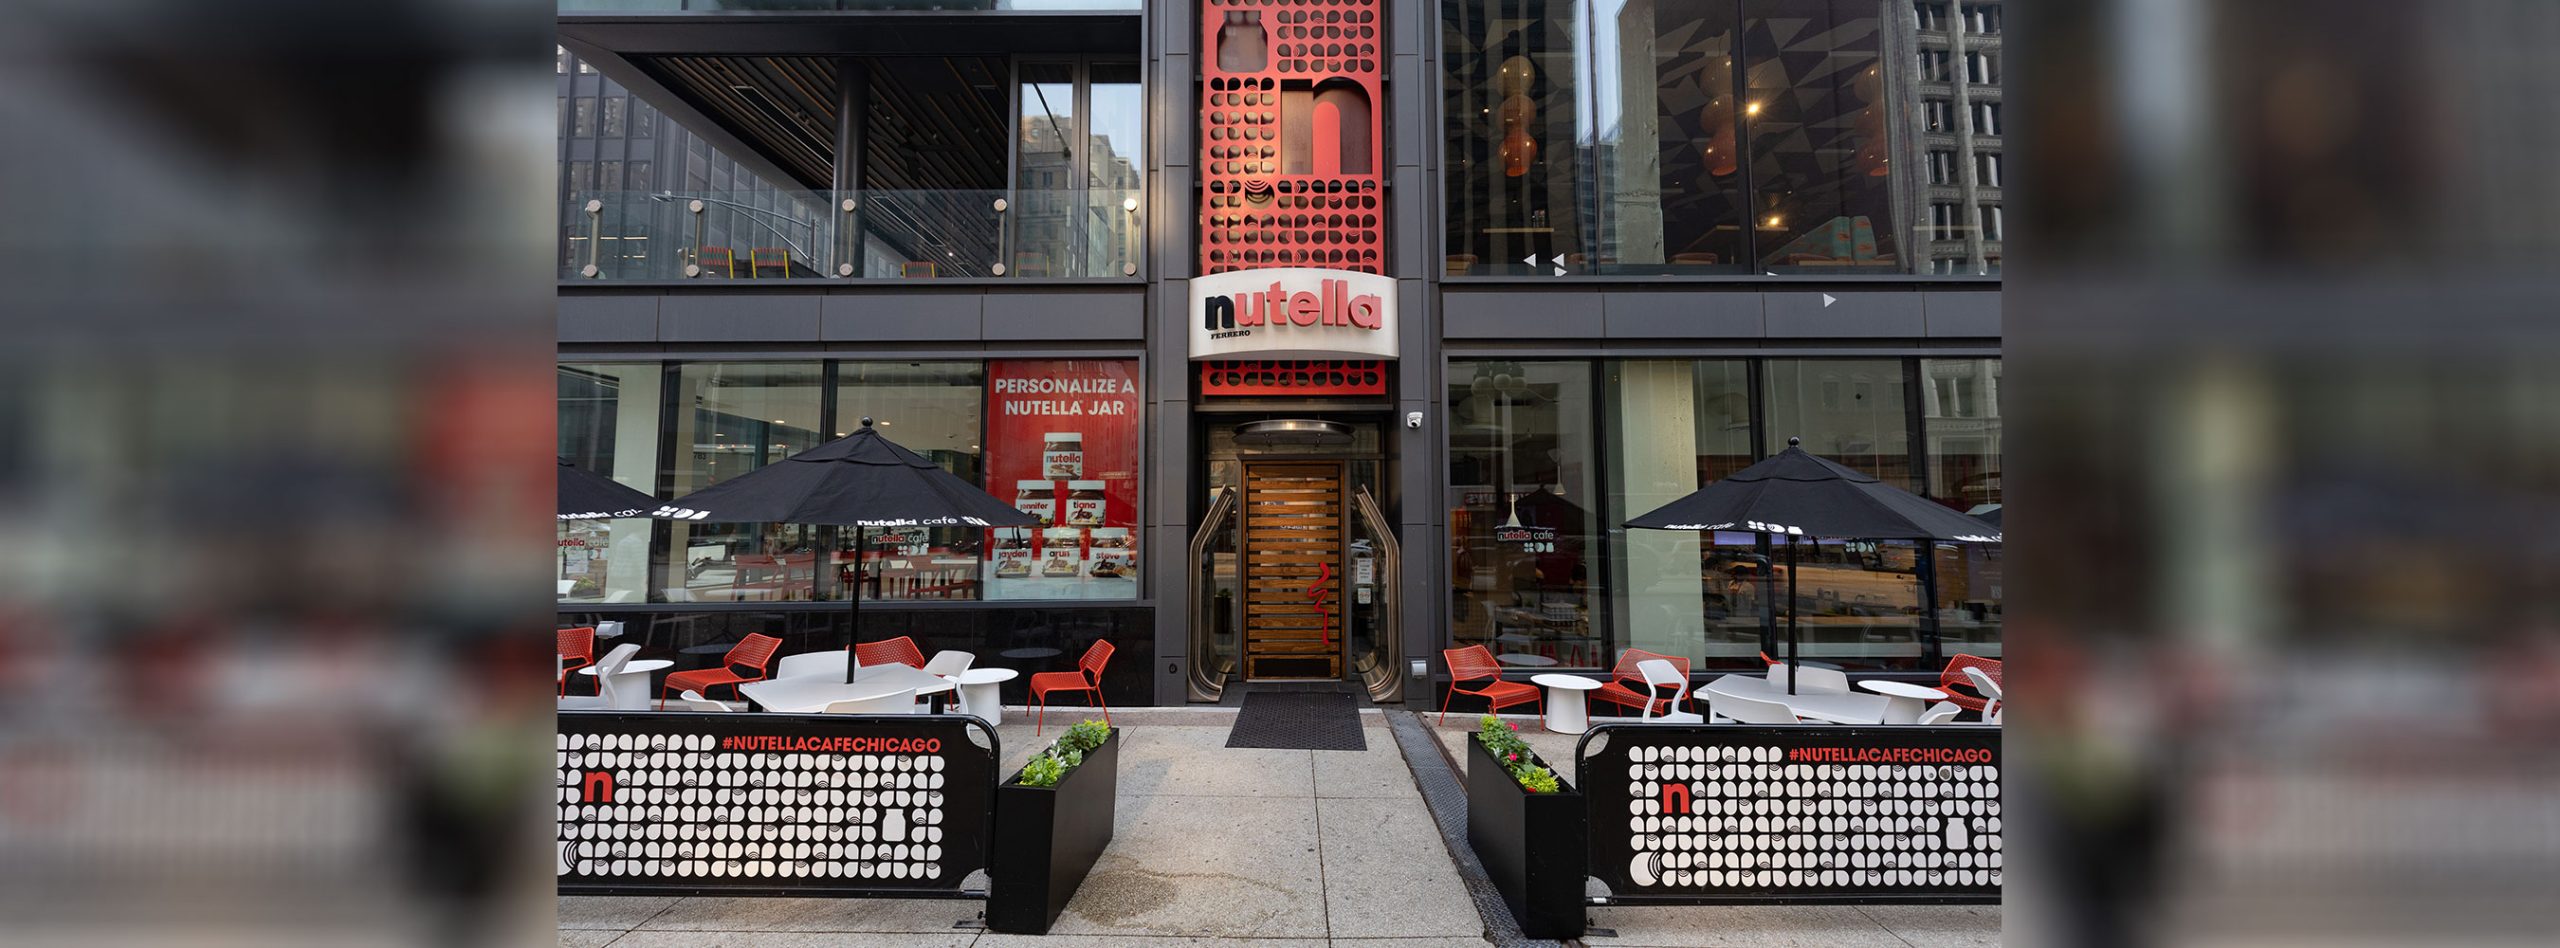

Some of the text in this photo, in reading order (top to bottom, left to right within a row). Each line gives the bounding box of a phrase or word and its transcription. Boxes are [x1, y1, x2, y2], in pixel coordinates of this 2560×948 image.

[1281, 76, 1372, 175] n
[1205, 278, 1382, 330] nutella
[1210, 330, 1251, 340] FERRERO
[995, 378, 1136, 394] PERSONALIZE A
[1088, 400, 1125, 416] JAR
[1046, 452, 1081, 463] nutella
[1073, 501, 1097, 509] tiana
[857, 516, 958, 527] nutella cafe
[871, 531, 929, 544] nutella cafe
[1497, 529, 1554, 541] nutella cafe
[557, 537, 585, 547] utella
[998, 550, 1028, 560] jayden
[1049, 549, 1070, 559] arun
[1095, 552, 1121, 560] steve
[722, 735, 942, 753] #NUTELLACAFECHICAGO
[1789, 747, 1993, 763] #NUTELLACAFECHICAGO
[584, 771, 613, 803] n
[1662, 783, 1690, 814] n
